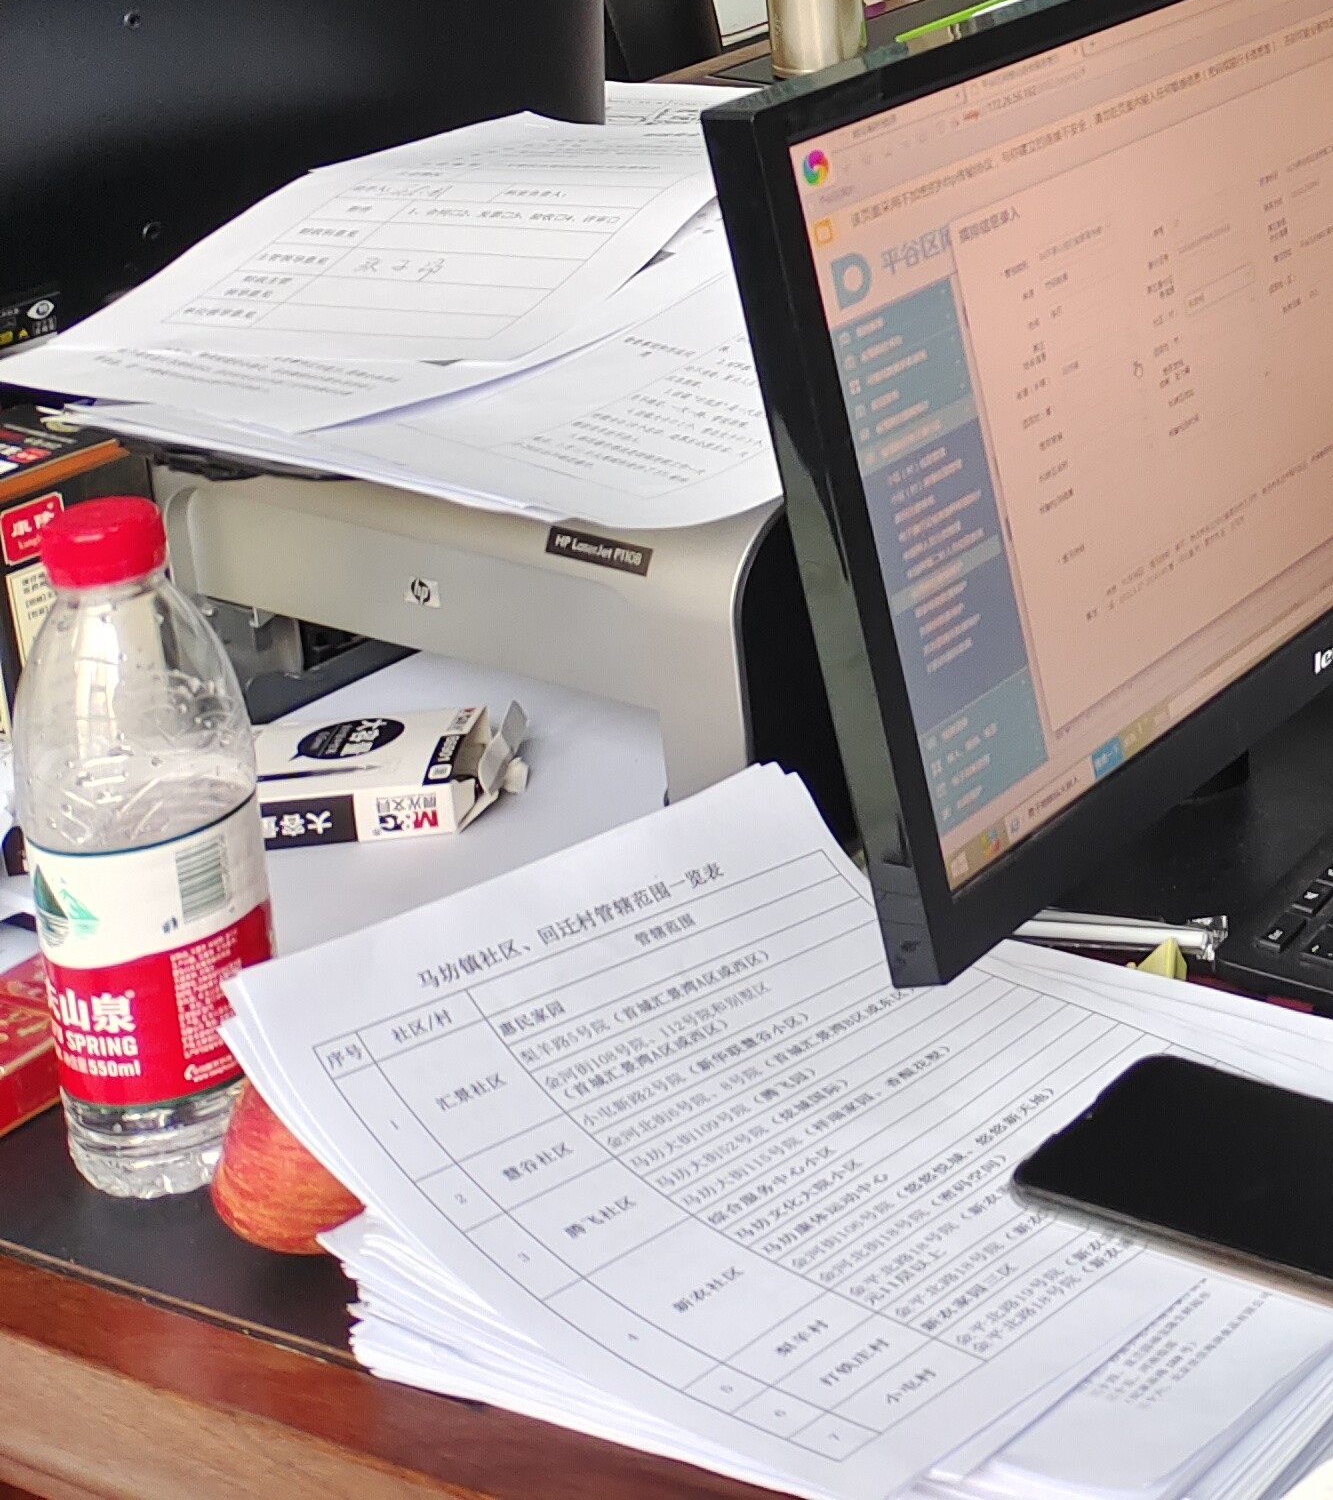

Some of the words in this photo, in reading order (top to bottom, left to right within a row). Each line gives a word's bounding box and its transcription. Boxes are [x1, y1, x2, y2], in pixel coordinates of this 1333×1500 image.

[554, 532, 573, 550] HP
[65, 1033, 139, 1058] SPRING
[326, 1042, 365, 1071] 序号
